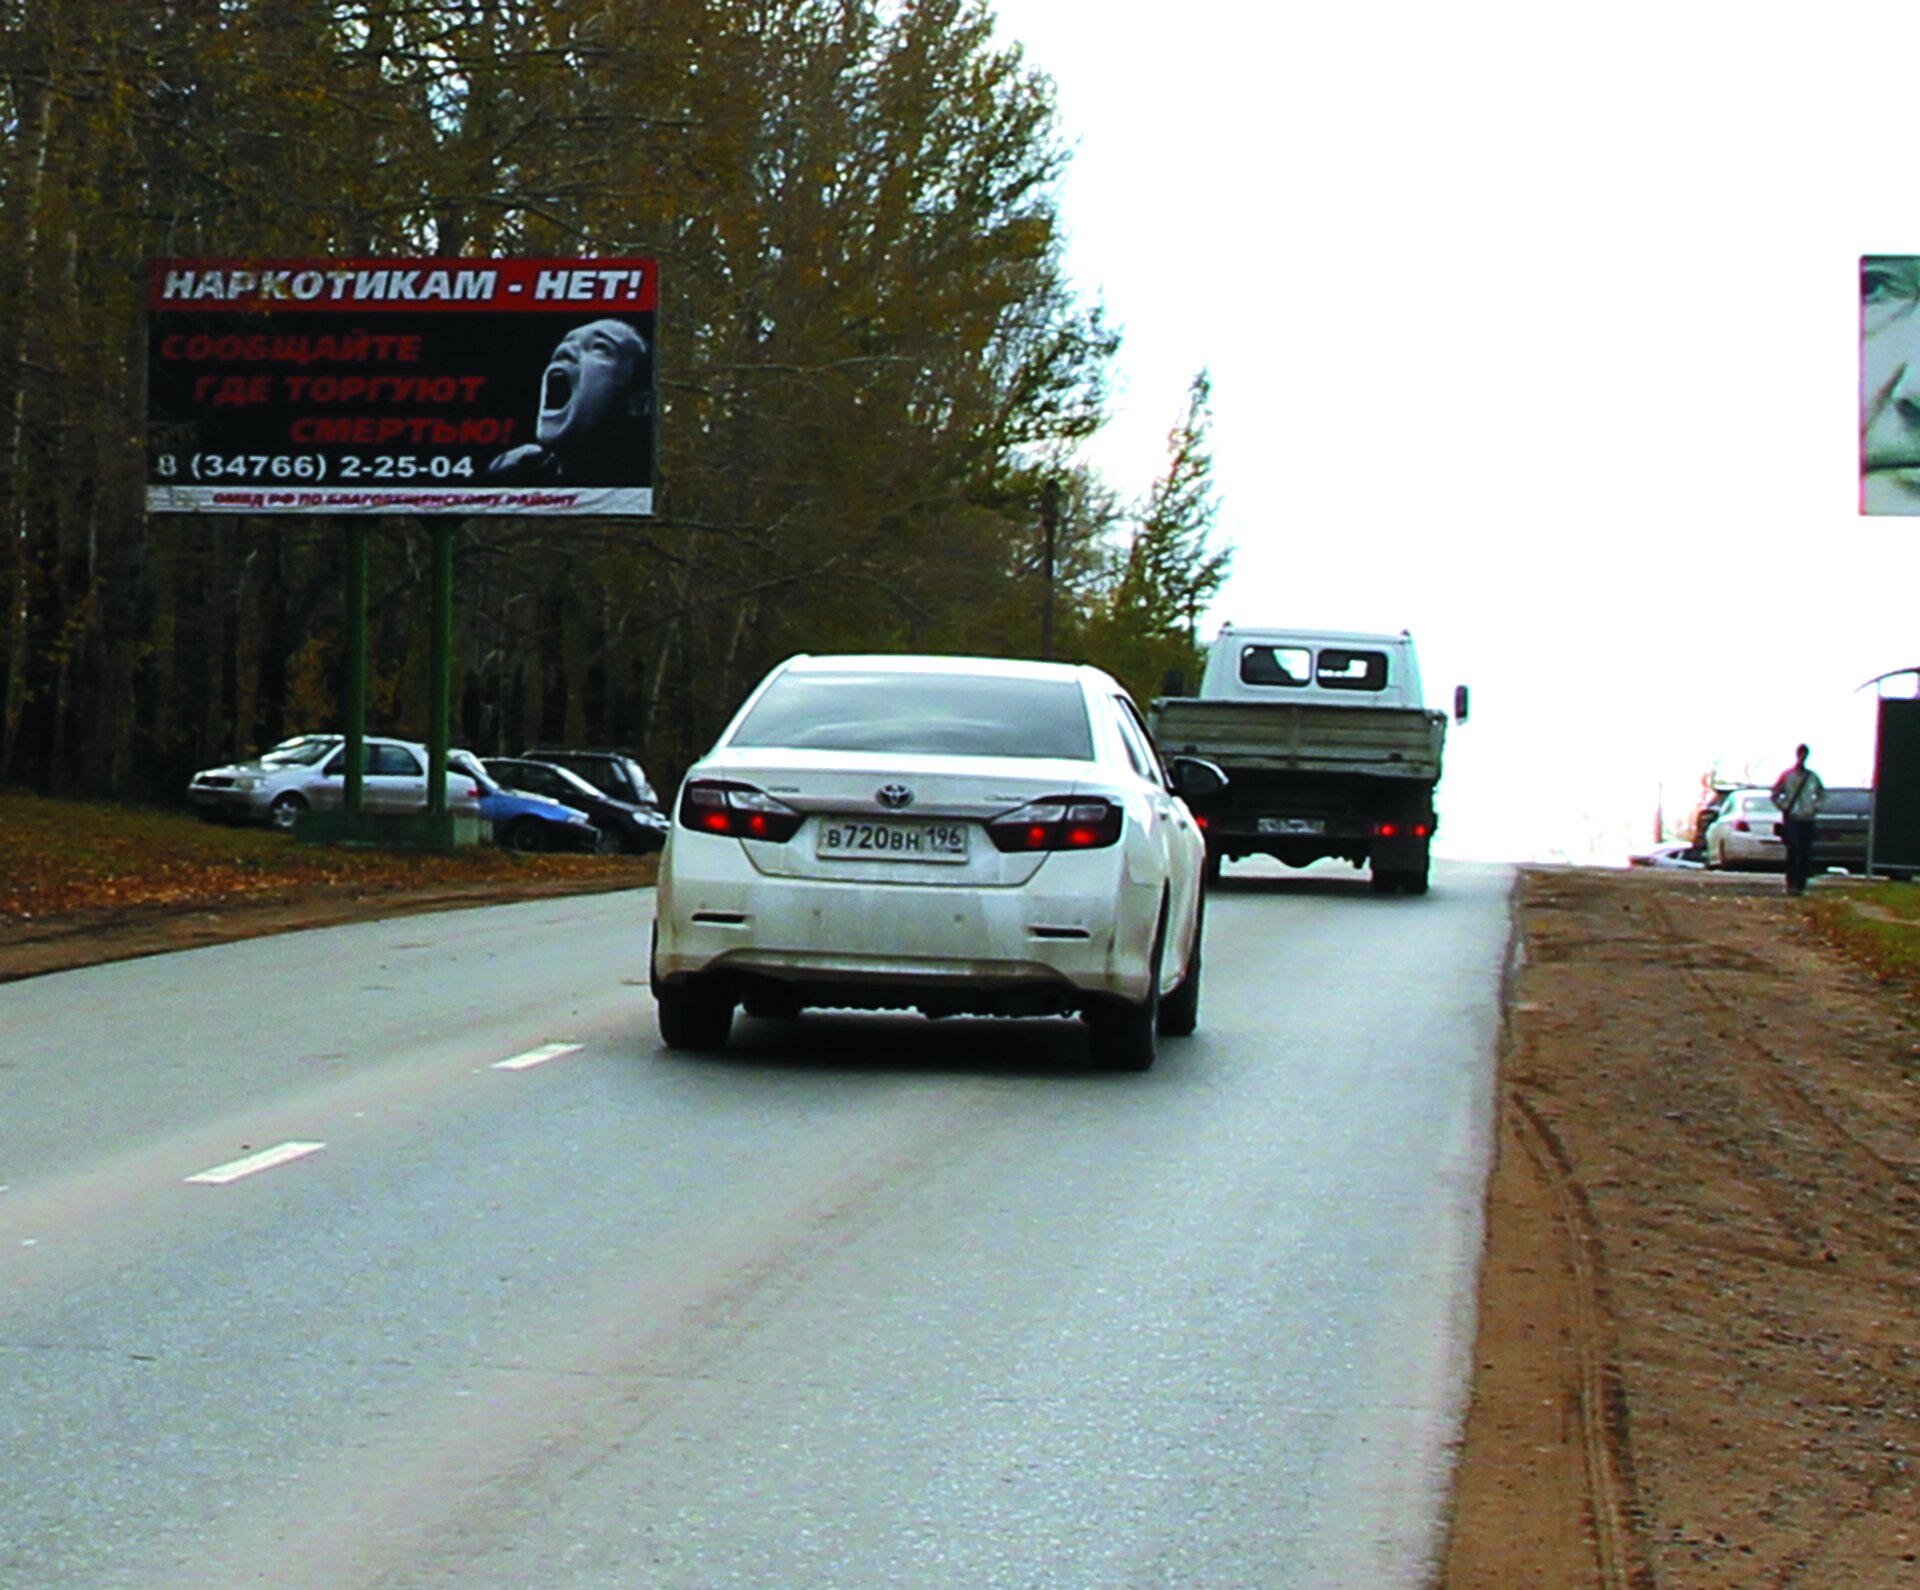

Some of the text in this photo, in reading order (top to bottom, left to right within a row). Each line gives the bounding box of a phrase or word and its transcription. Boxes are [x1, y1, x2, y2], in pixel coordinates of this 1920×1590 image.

[162, 270, 642, 299] НАРКОТИКАМ - НЕТ!
[161, 328, 422, 363] СООБЩАЙТЕ
[194, 376, 486, 407] ГДЕ ТОРГУЮТ
[290, 417, 514, 443] СМЕРТЬЮ!
[158, 453, 474, 481] 8 (34766) 2-25-04
[299, 493, 323, 505] ПО
[926, 828, 961, 845] 196
